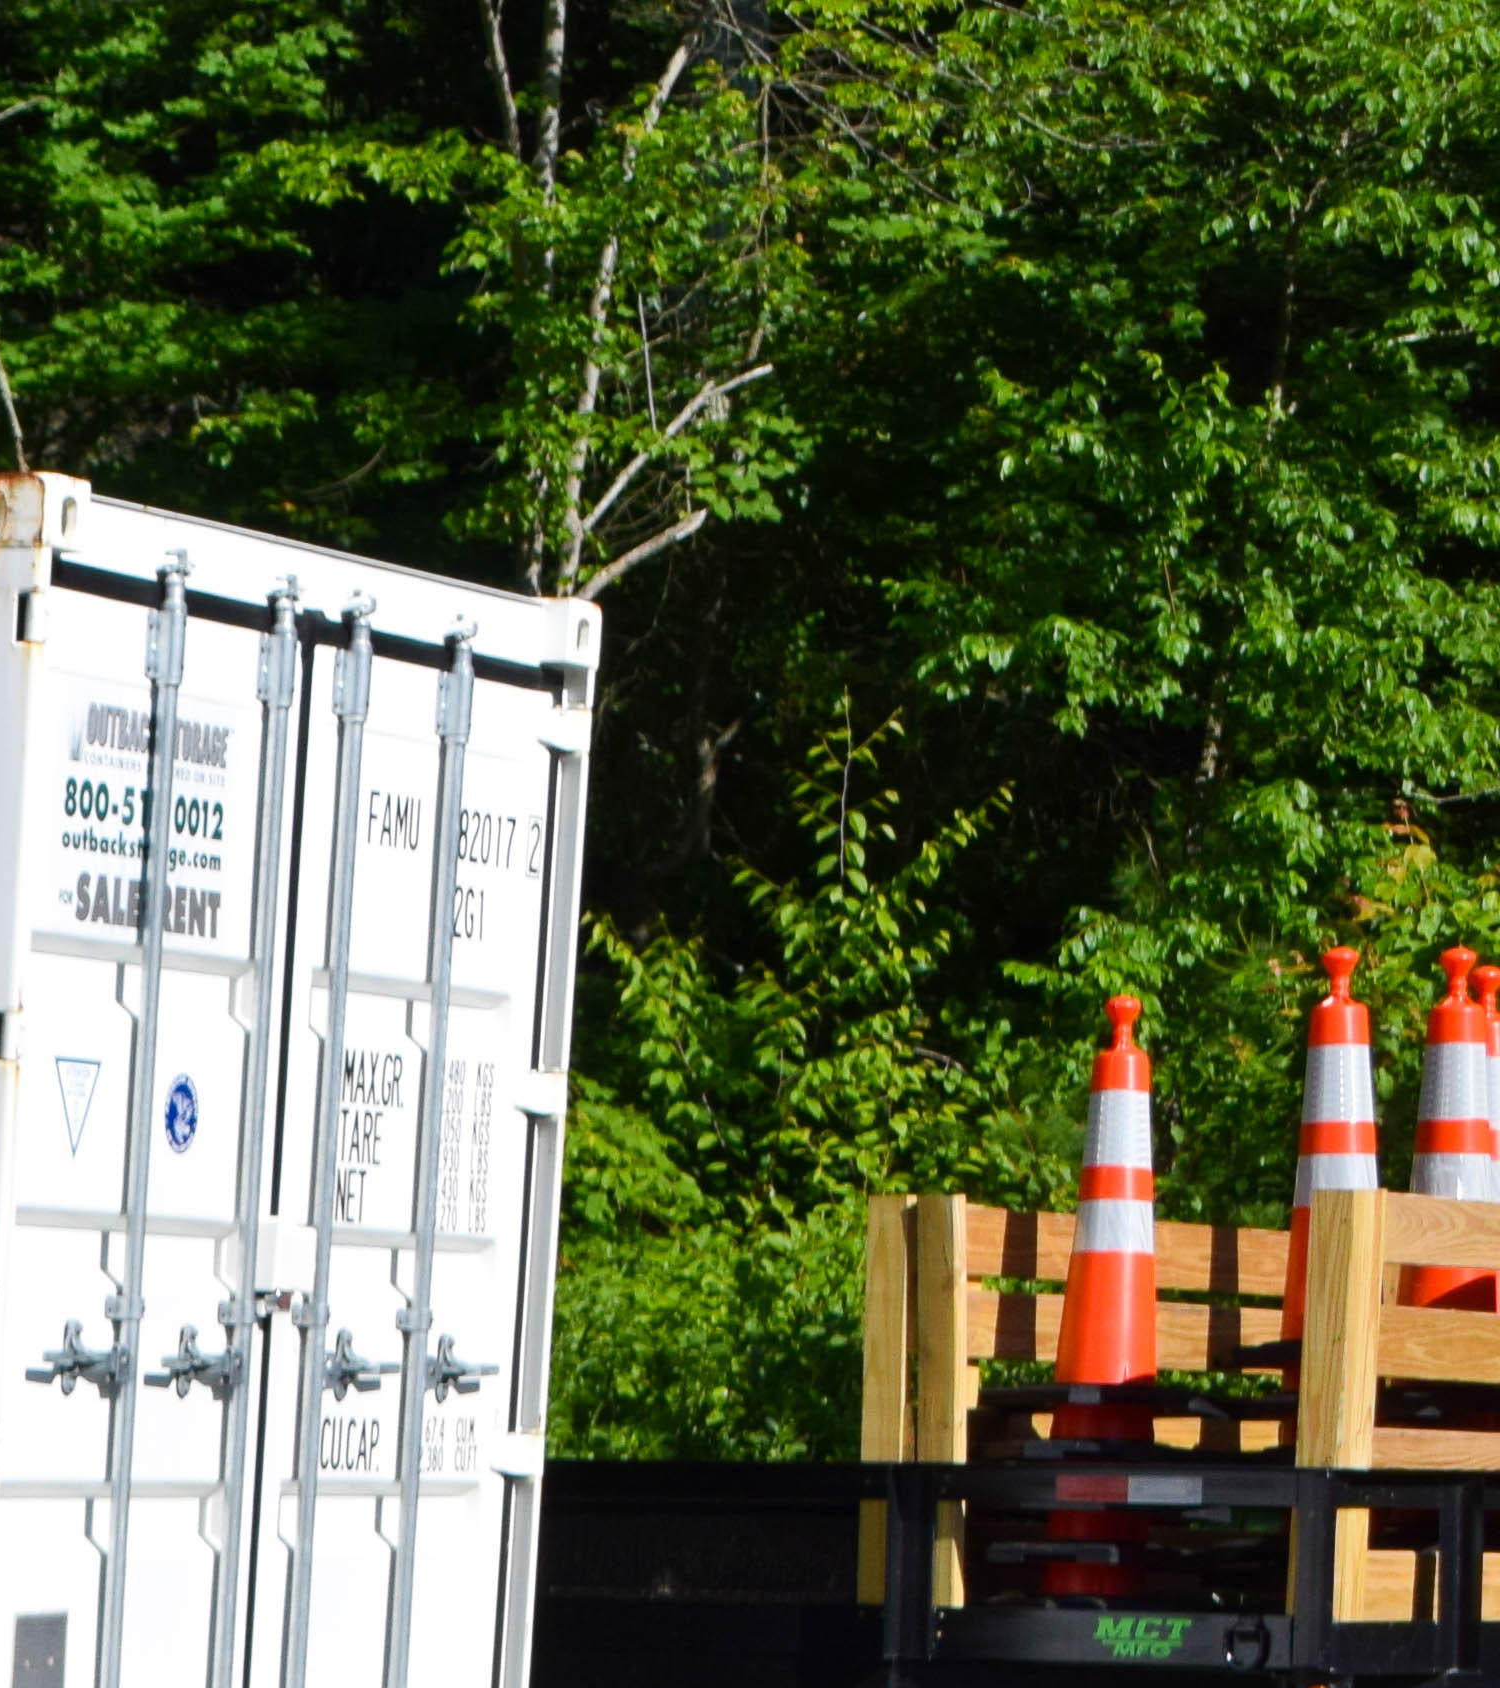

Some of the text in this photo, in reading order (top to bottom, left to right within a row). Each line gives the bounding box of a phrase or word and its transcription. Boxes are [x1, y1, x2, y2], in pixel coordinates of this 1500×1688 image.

[86, 702, 230, 769] OUTBAC TORAGE
[368, 789, 421, 850] FAMU
[75, 870, 145, 928] SALE
[341, 1109, 383, 1165] TARE
[335, 1168, 367, 1225] NET
[1094, 1616, 1192, 1641] MCT
[1111, 1641, 1172, 1659] MFG
